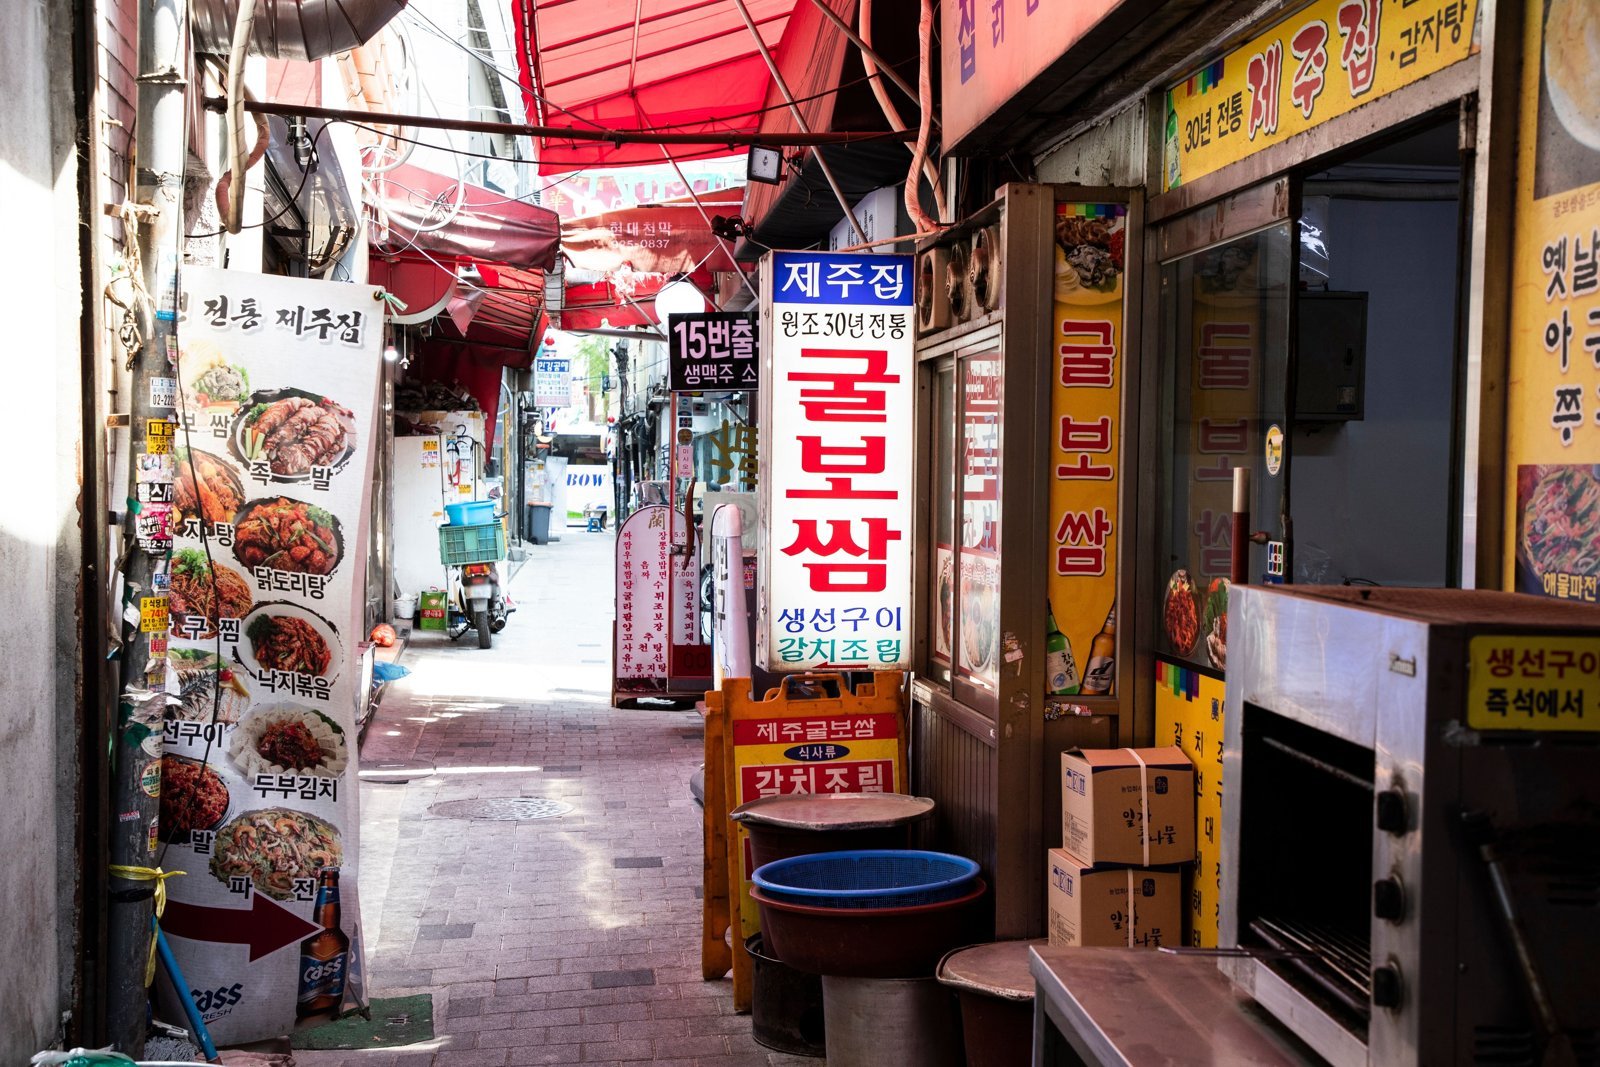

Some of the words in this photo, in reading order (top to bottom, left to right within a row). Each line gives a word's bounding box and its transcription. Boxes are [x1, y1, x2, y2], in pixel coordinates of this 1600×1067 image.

[1400, 0, 1467, 69] 감자탕
[1185, 107, 1212, 154] 30년
[1216, 91, 1244, 139] 전통
[782, 261, 904, 299] 제주집
[274, 304, 363, 344] 제주집
[673, 319, 759, 360] 15번출
[684, 363, 735, 385] 생맥주
[1055, 320, 1116, 577] 굴보쌈
[566, 473, 603, 487] BOW
[780, 347, 901, 593] 굴보쌈
[255, 567, 326, 599] 닭도리탕
[1544, 572, 1597, 602] 해물파전
[777, 606, 901, 633] 생선구이
[777, 637, 901, 663] 갈치조림
[258, 671, 331, 700] 낙지볶음
[1485, 687, 1584, 719] 즉석에서
[757, 718, 876, 742] 제주굴보쌈
[799, 745, 836, 759] 식사류
[253, 776, 337, 801] 두부김치
